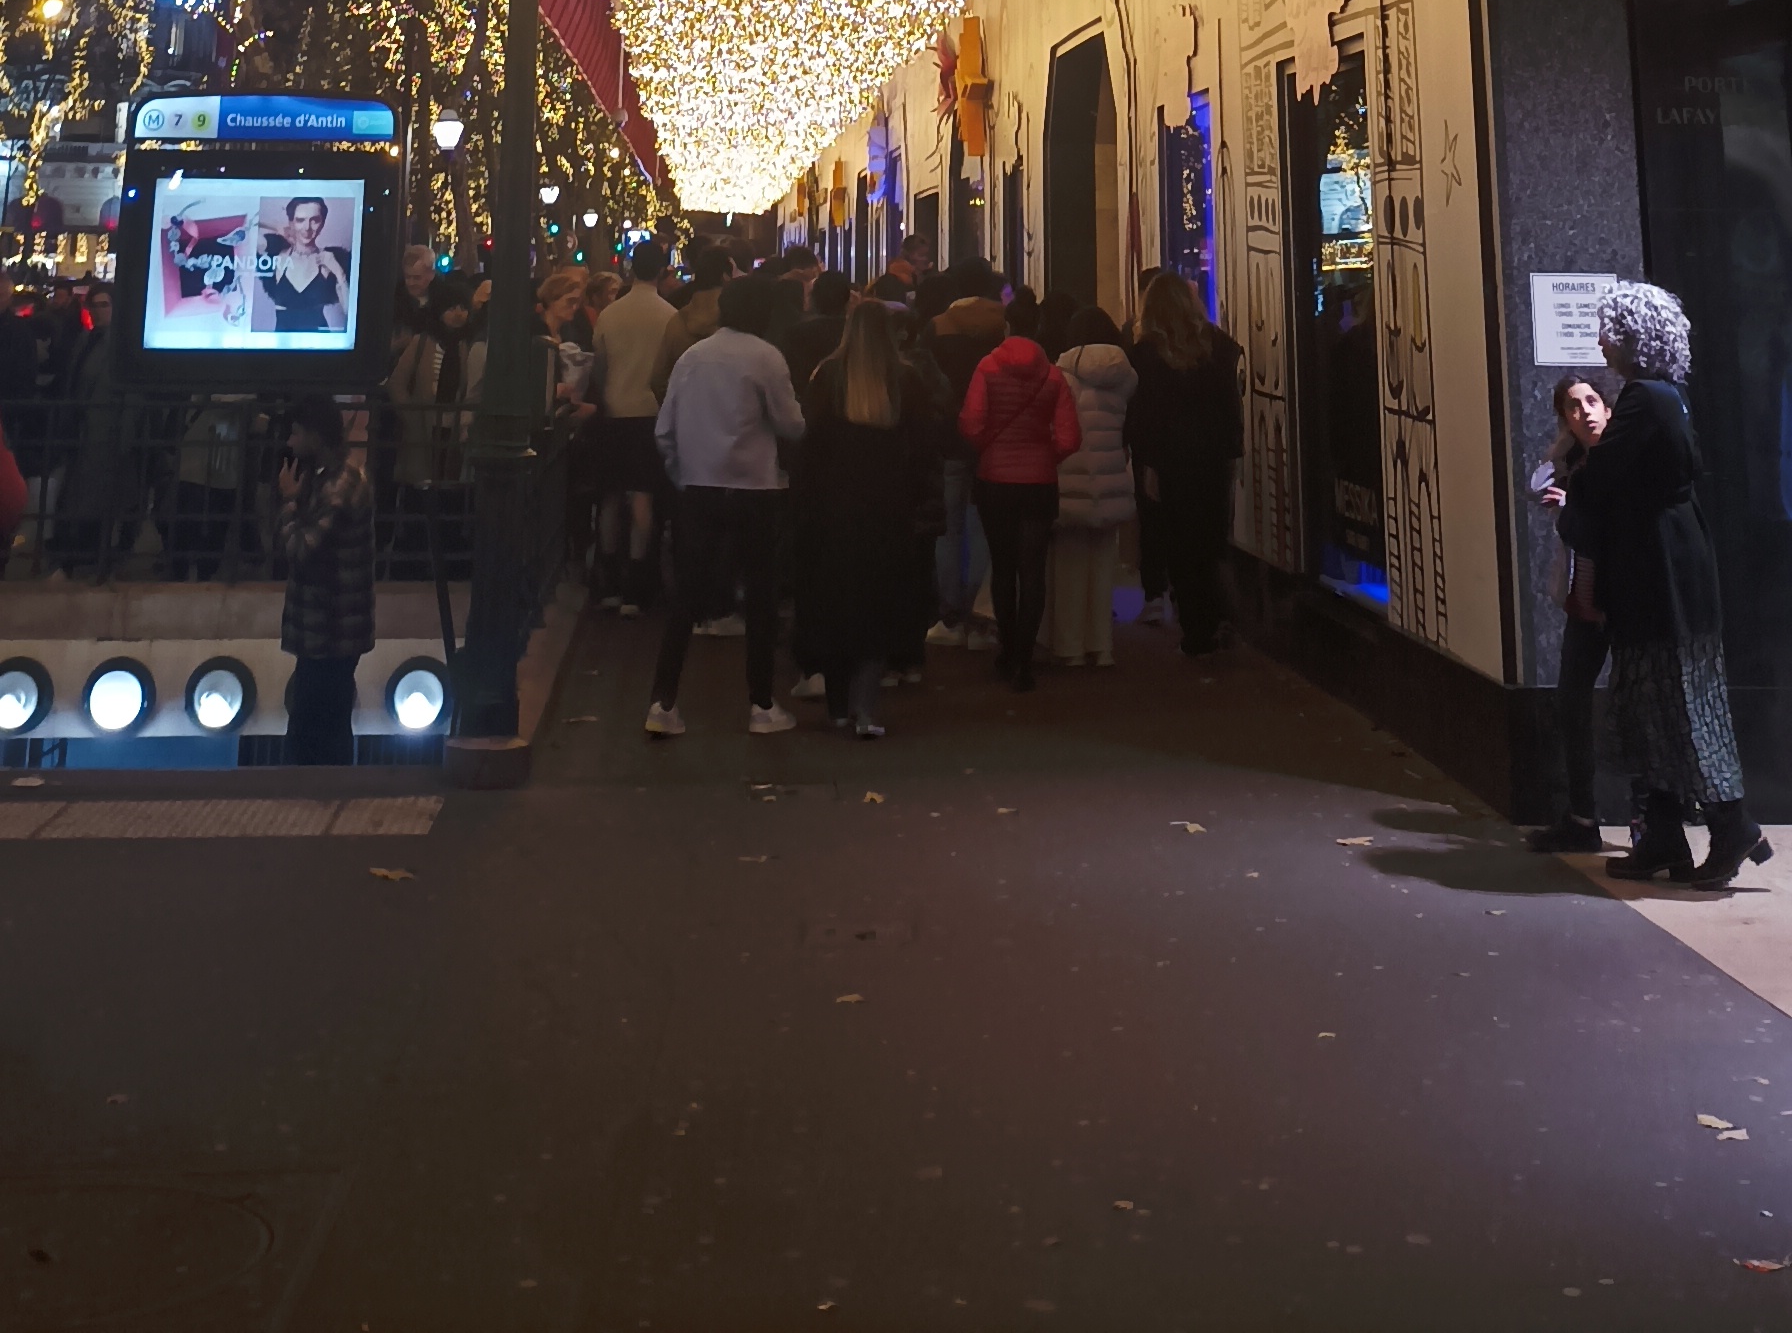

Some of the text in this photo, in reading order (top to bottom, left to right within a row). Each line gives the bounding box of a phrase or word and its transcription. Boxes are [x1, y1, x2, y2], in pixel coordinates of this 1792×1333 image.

[174, 114, 183, 126] 7
[197, 114, 206, 126] 9
[226, 113, 291, 128] Chaussée
[295, 113, 346, 128] d'Antin
[211, 254, 295, 271] PANDORA
[1552, 282, 1596, 292] HORAIRES
